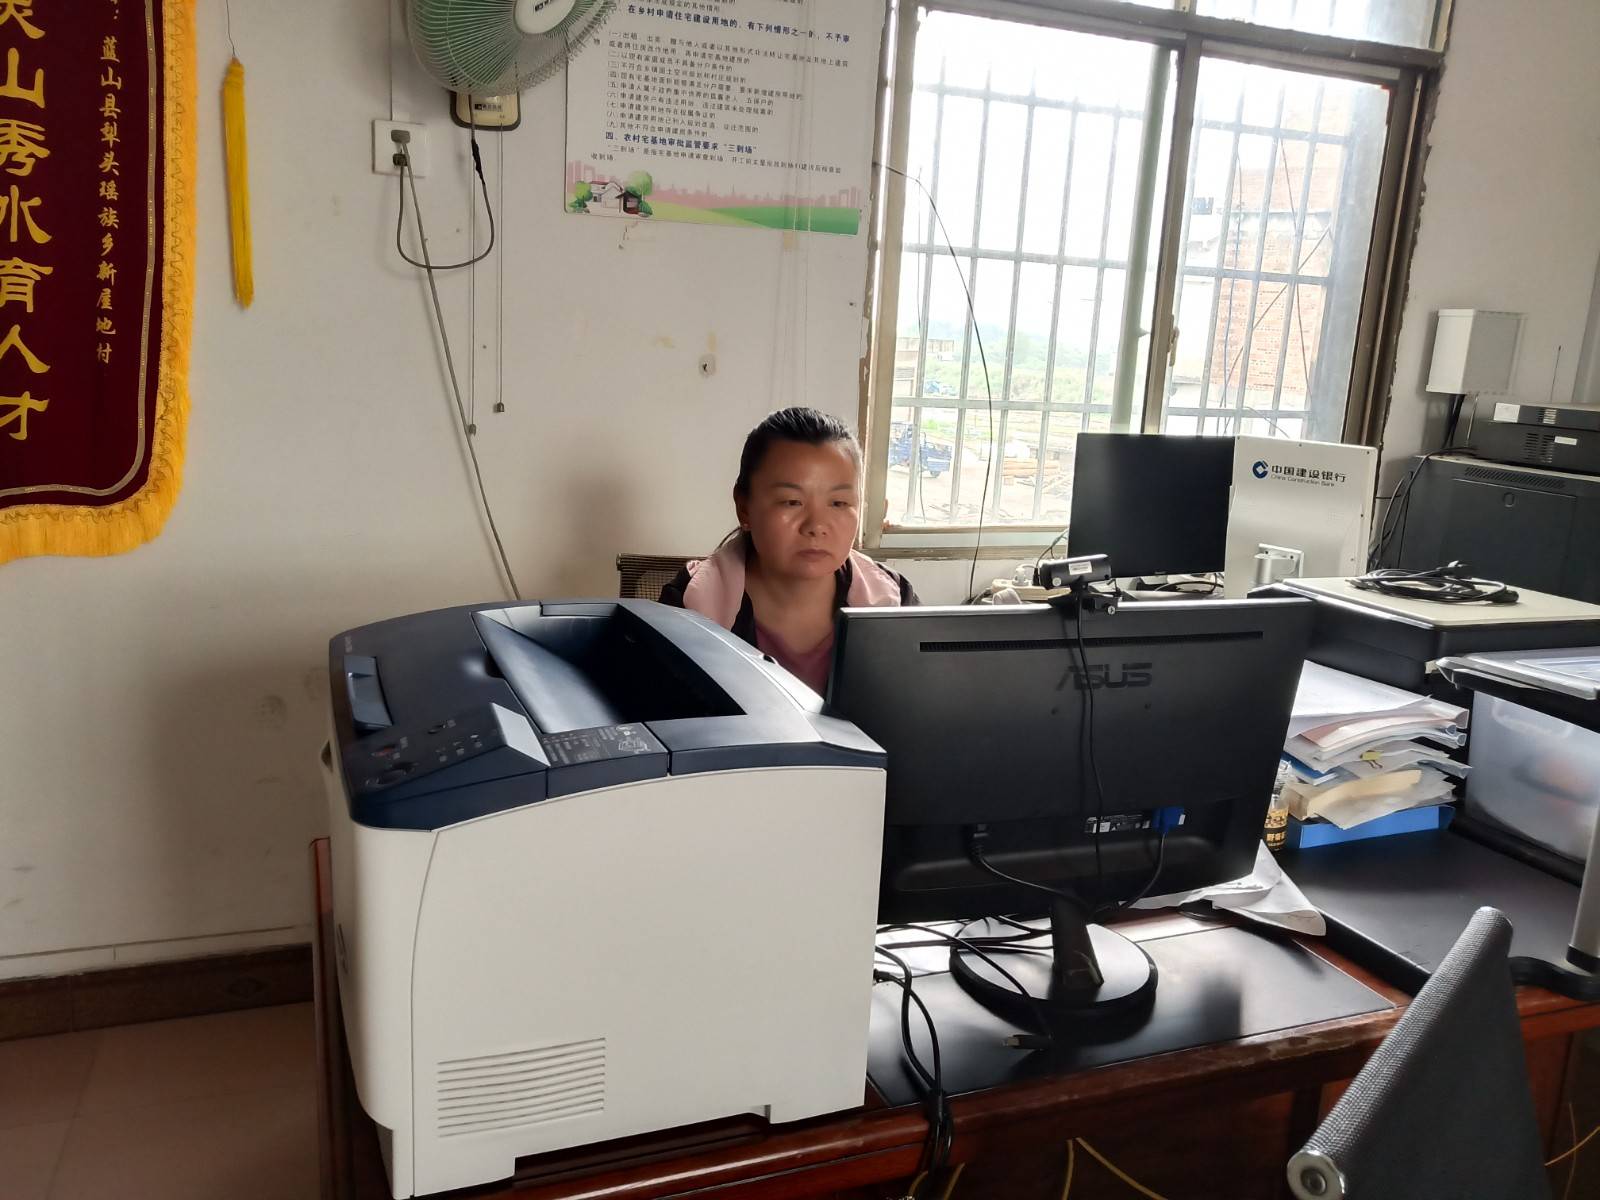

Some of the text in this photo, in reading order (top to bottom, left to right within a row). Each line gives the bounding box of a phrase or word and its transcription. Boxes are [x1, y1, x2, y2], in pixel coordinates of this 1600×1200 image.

[1271, 465, 1346, 483] 中国建设银行
[1055, 662, 1153, 692] ASUS
